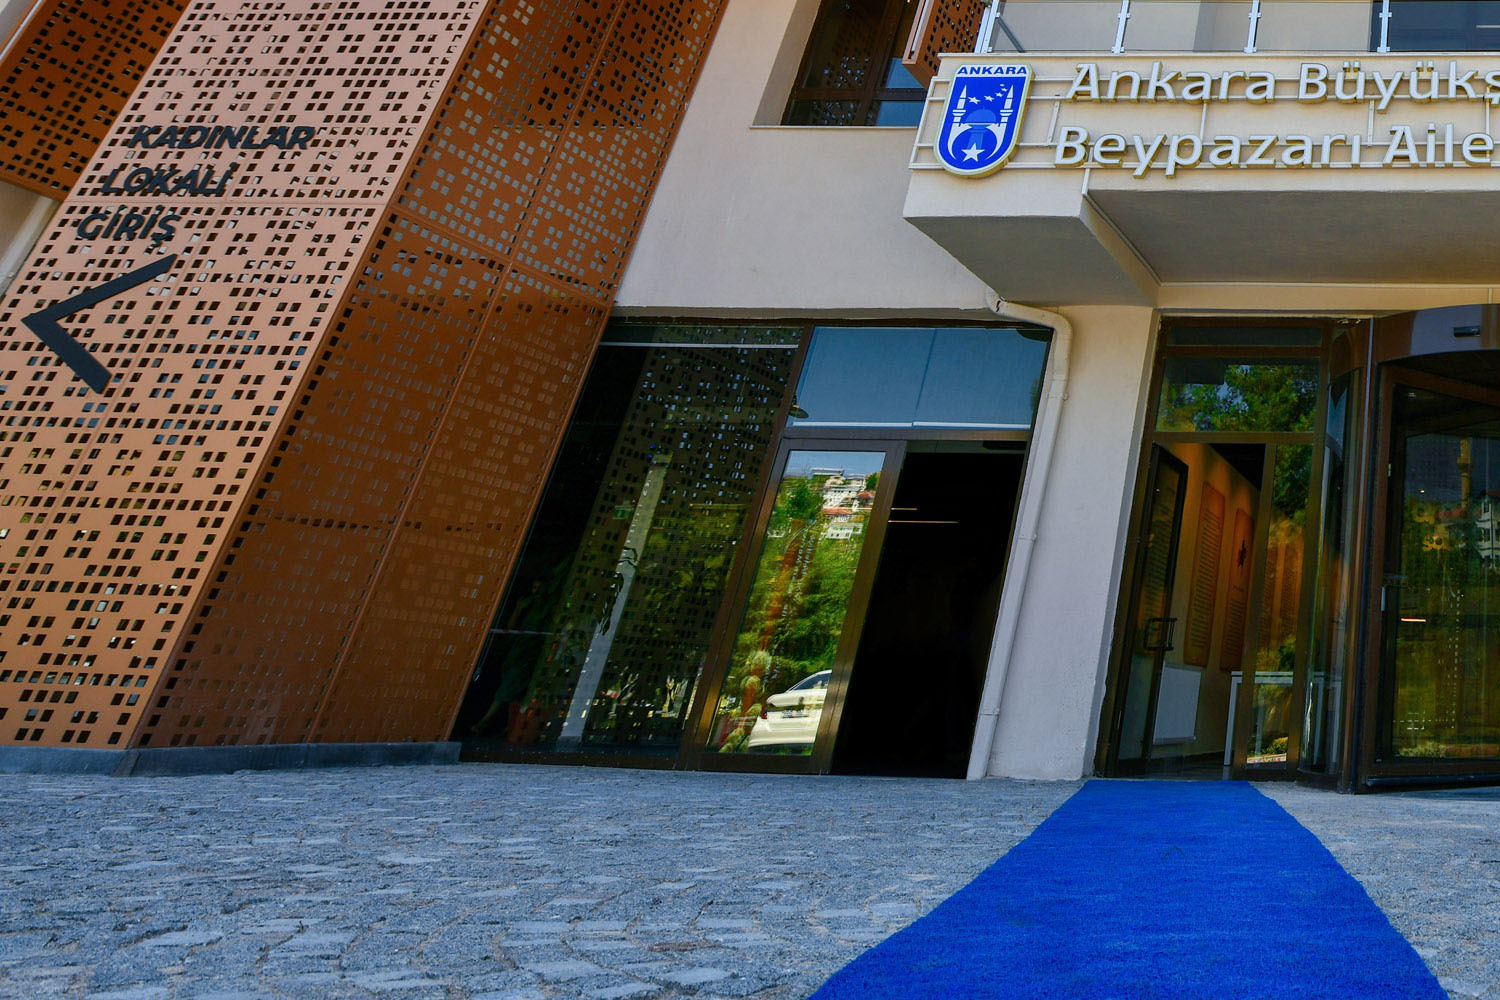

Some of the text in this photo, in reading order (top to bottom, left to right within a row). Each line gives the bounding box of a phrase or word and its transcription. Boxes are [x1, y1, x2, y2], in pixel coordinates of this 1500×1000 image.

[956, 64, 1029, 76] ANKARA
[1066, 60, 1277, 103] Ankara
[128, 125, 316, 150] KADINLAR
[1053, 125, 1365, 180] Beypazarı
[1382, 124, 1495, 167] Aile
[100, 161, 239, 195] LOKALİ
[76, 204, 182, 248] GİRİŞ
